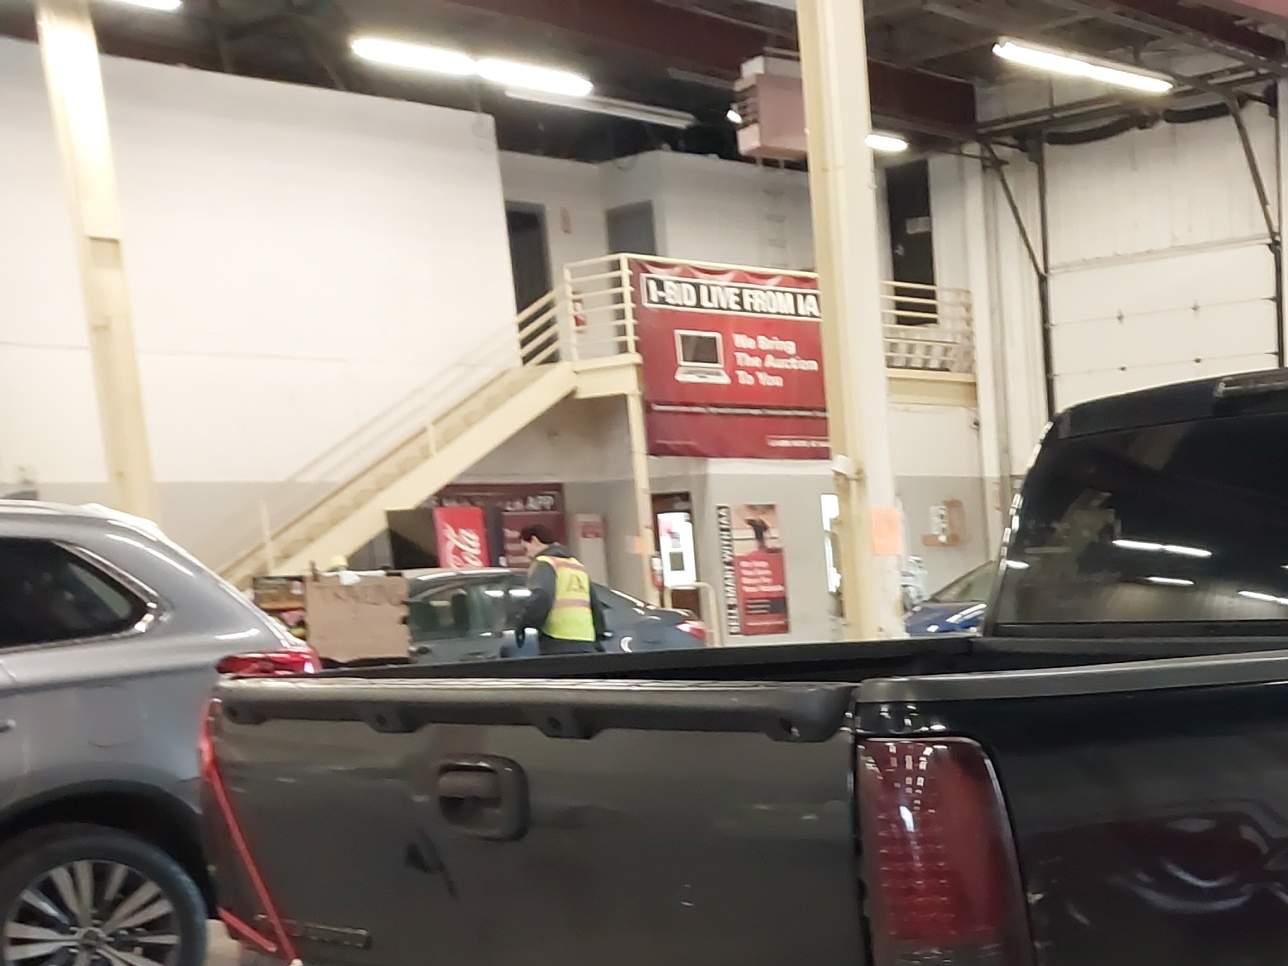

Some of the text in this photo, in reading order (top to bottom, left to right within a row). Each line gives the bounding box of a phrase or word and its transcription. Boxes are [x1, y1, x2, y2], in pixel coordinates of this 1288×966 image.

[700, 284, 743, 310] LIVE
[743, 289, 795, 314] FROM
[764, 354, 818, 371] Auction
[755, 371, 783, 387] You
